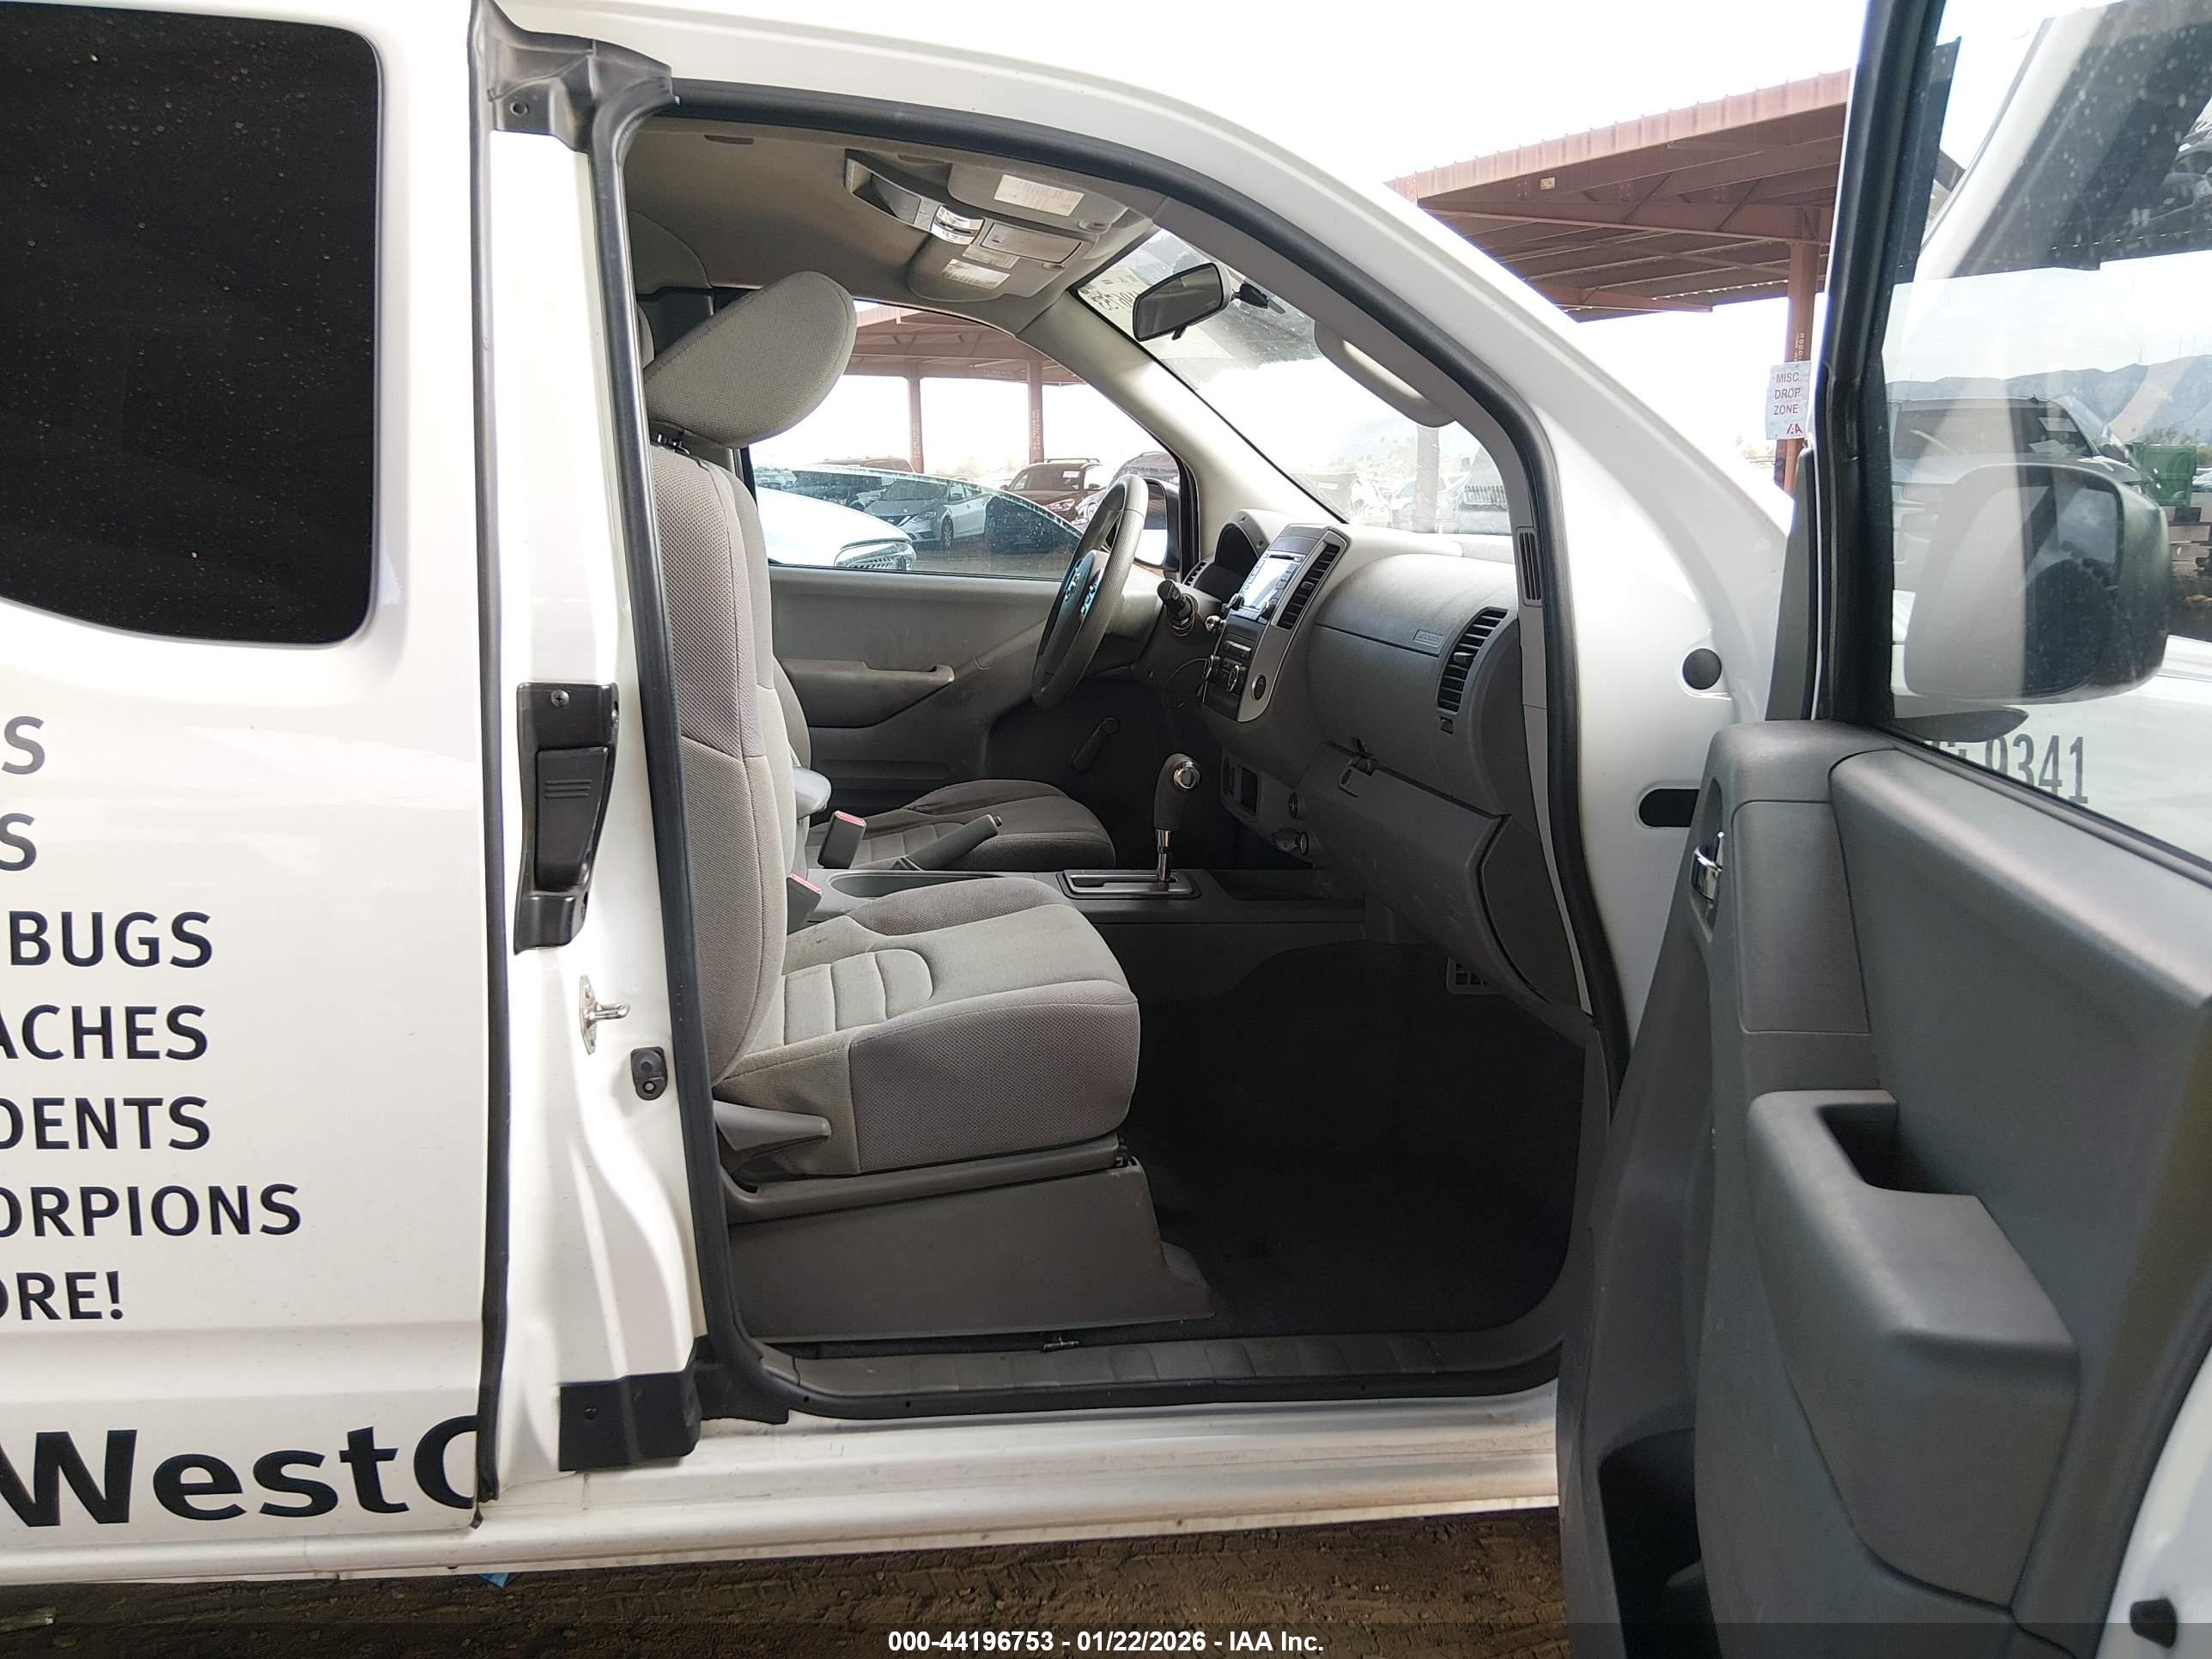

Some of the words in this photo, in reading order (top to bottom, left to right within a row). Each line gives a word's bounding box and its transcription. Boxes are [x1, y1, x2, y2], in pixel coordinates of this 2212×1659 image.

[1774, 387, 1801, 399] DROP
[1776, 372, 1800, 384] MISC
[1773, 404, 1799, 415] ZONE
[2, 715, 46, 775] S
[0, 812, 37, 872] S
[9, 910, 212, 969] BUGS
[0, 1270, 124, 1321] RE!
